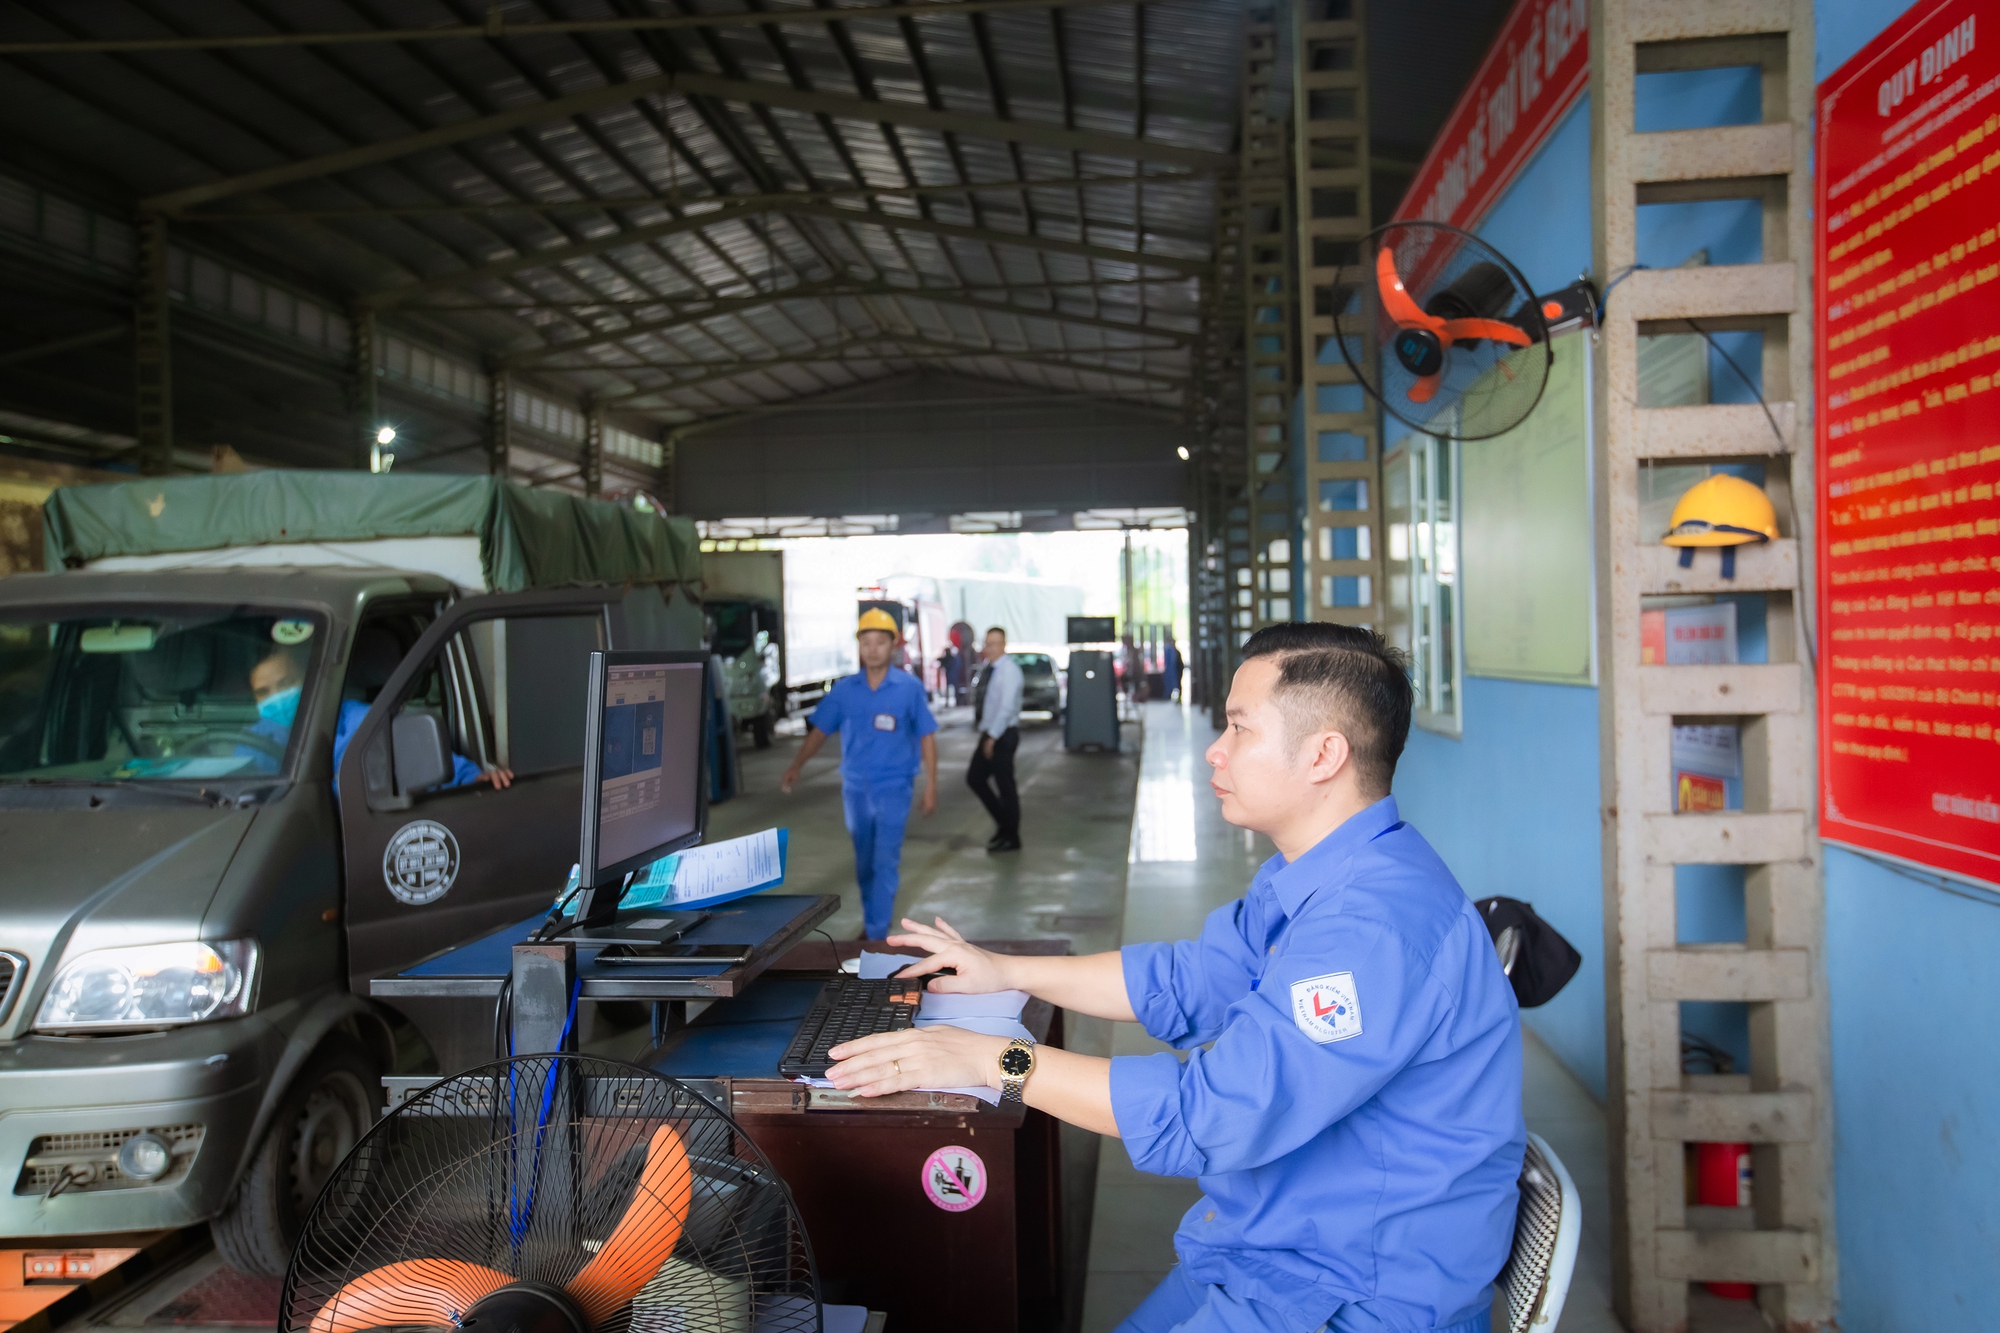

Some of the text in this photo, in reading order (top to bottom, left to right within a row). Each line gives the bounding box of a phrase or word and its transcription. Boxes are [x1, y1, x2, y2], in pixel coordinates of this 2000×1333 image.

[1878, 57, 1918, 117] QUY
[1920, 14, 1976, 83] ĐỊNH
[1299, 998, 1314, 1026] VIETNAM
